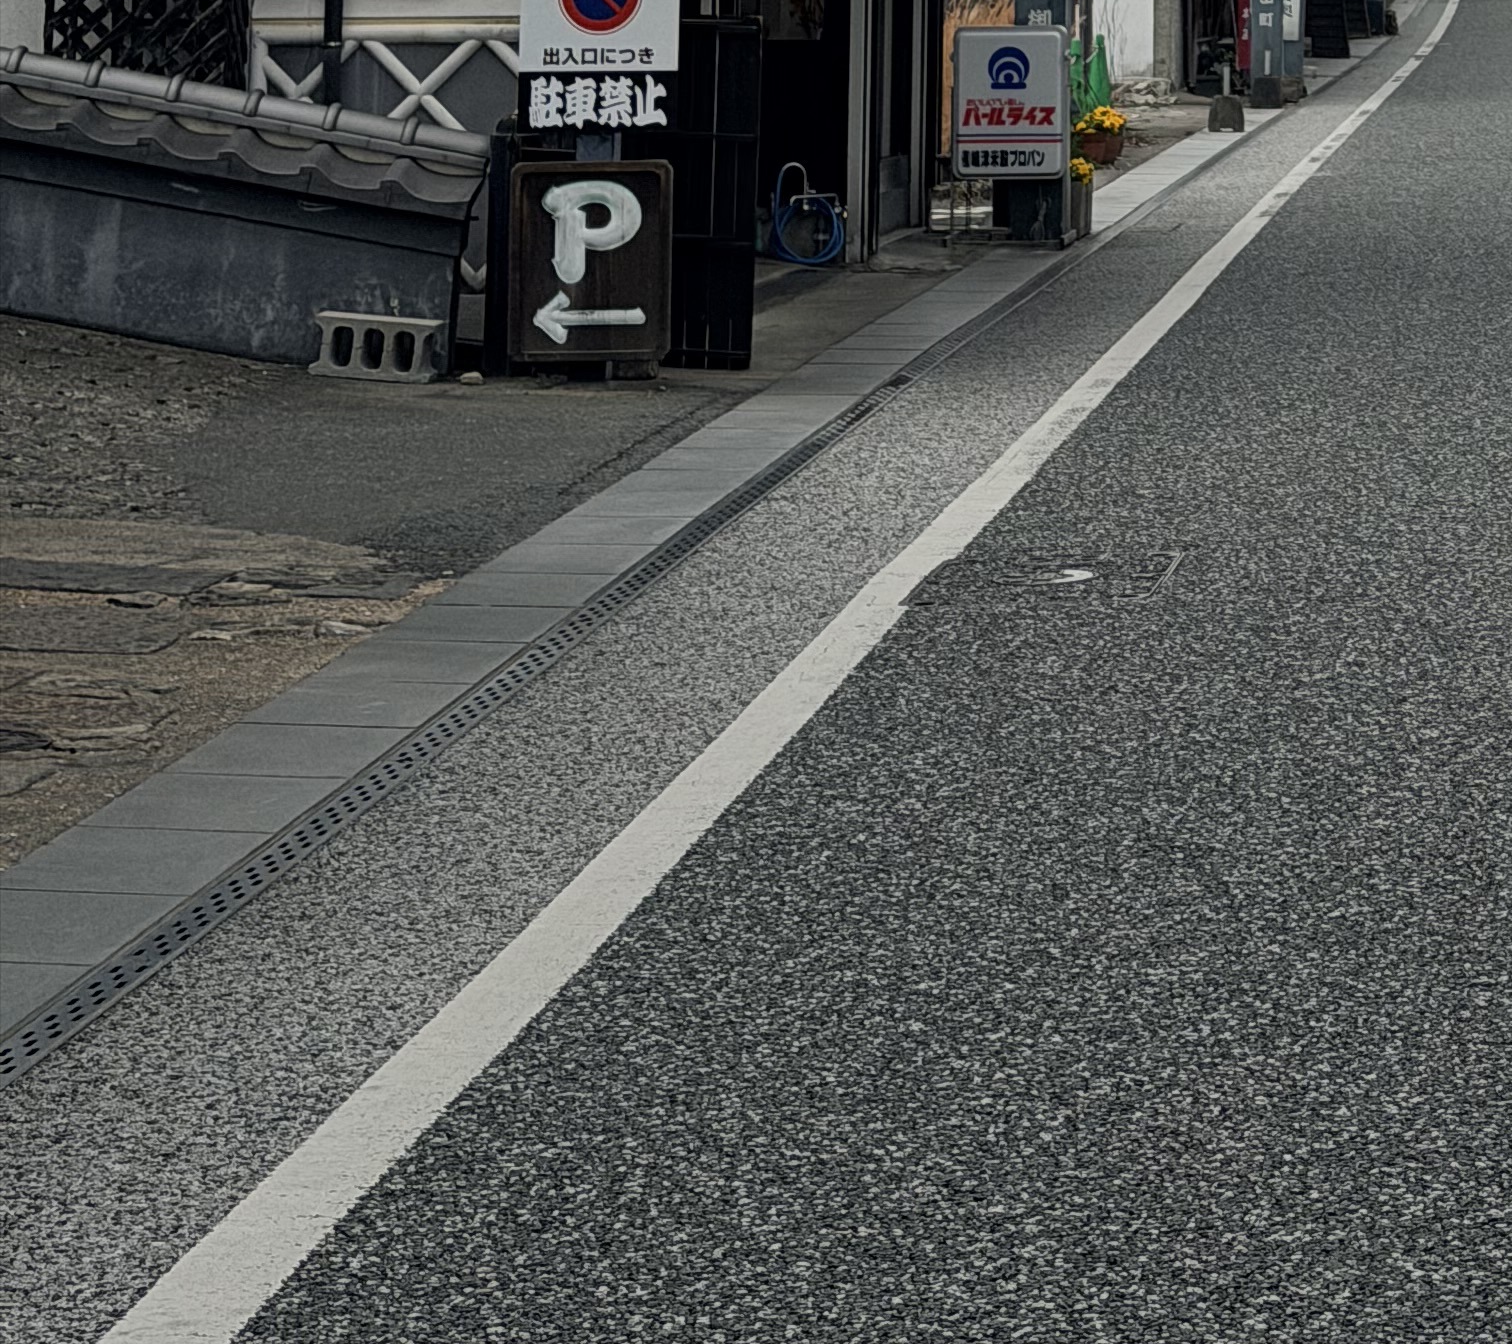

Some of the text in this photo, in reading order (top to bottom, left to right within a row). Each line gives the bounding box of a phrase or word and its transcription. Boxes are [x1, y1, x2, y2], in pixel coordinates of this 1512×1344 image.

[543, 47, 655, 66] 出入口につき
[529, 74, 667, 129] 駐車禁止
[962, 105, 1056, 127] パールライス
[541, 180, 643, 284] P
